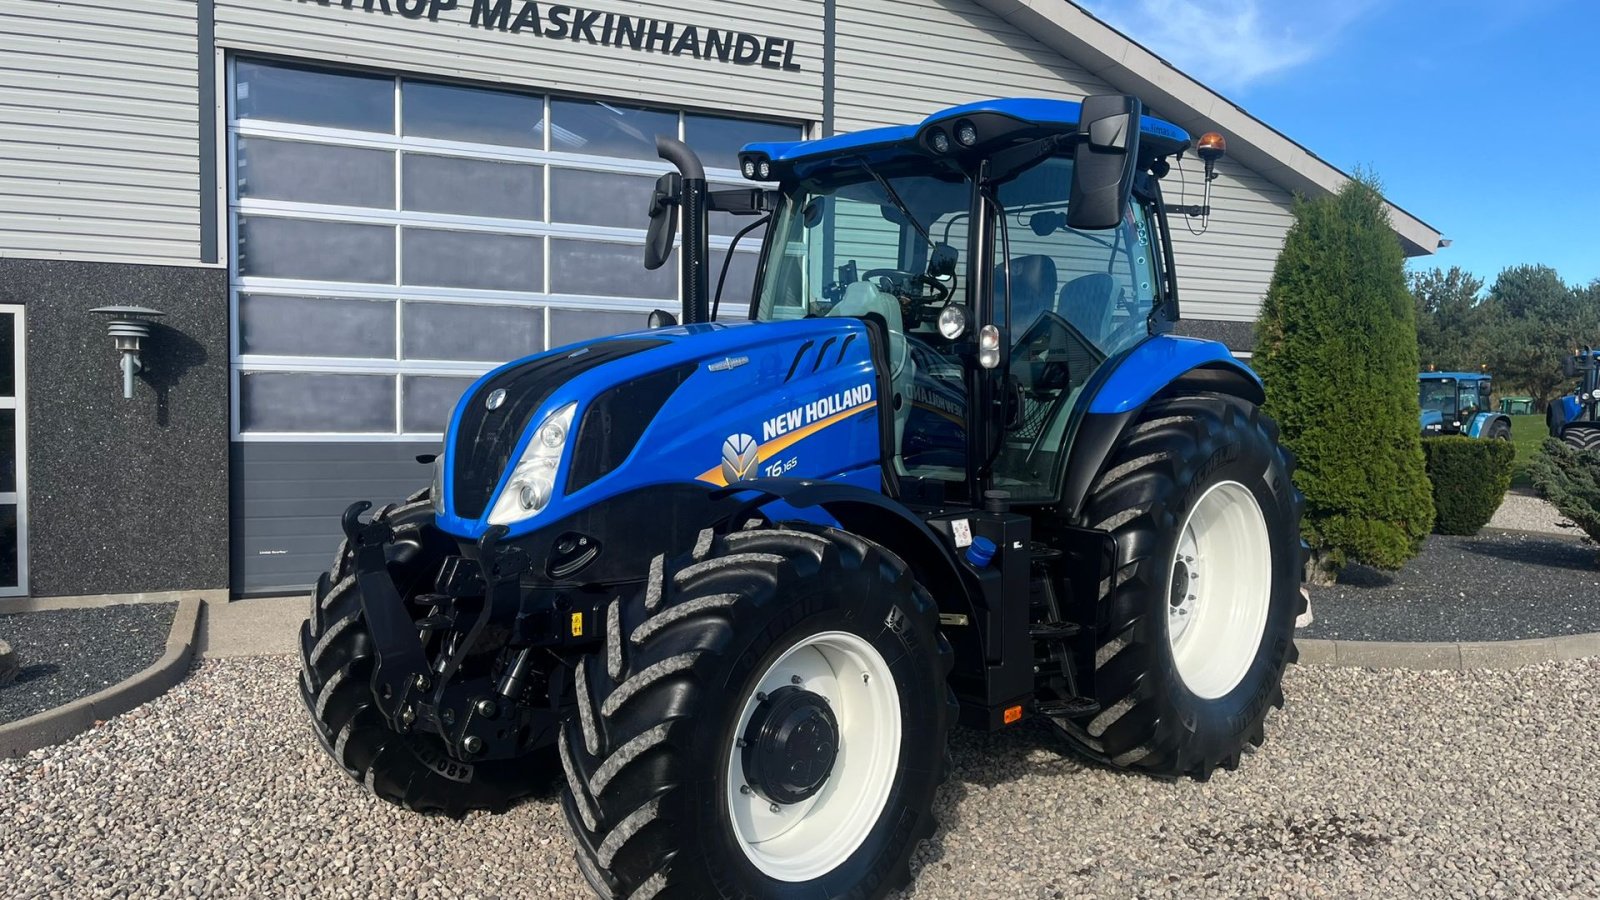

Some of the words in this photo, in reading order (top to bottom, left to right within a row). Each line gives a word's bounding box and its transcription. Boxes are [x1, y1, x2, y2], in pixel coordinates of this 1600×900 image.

[470, 0, 800, 71] MASKINHANDEL
[762, 407, 803, 441] NEW
[805, 383, 871, 423] HOLLAND
[765, 456, 798, 477] T6.165
